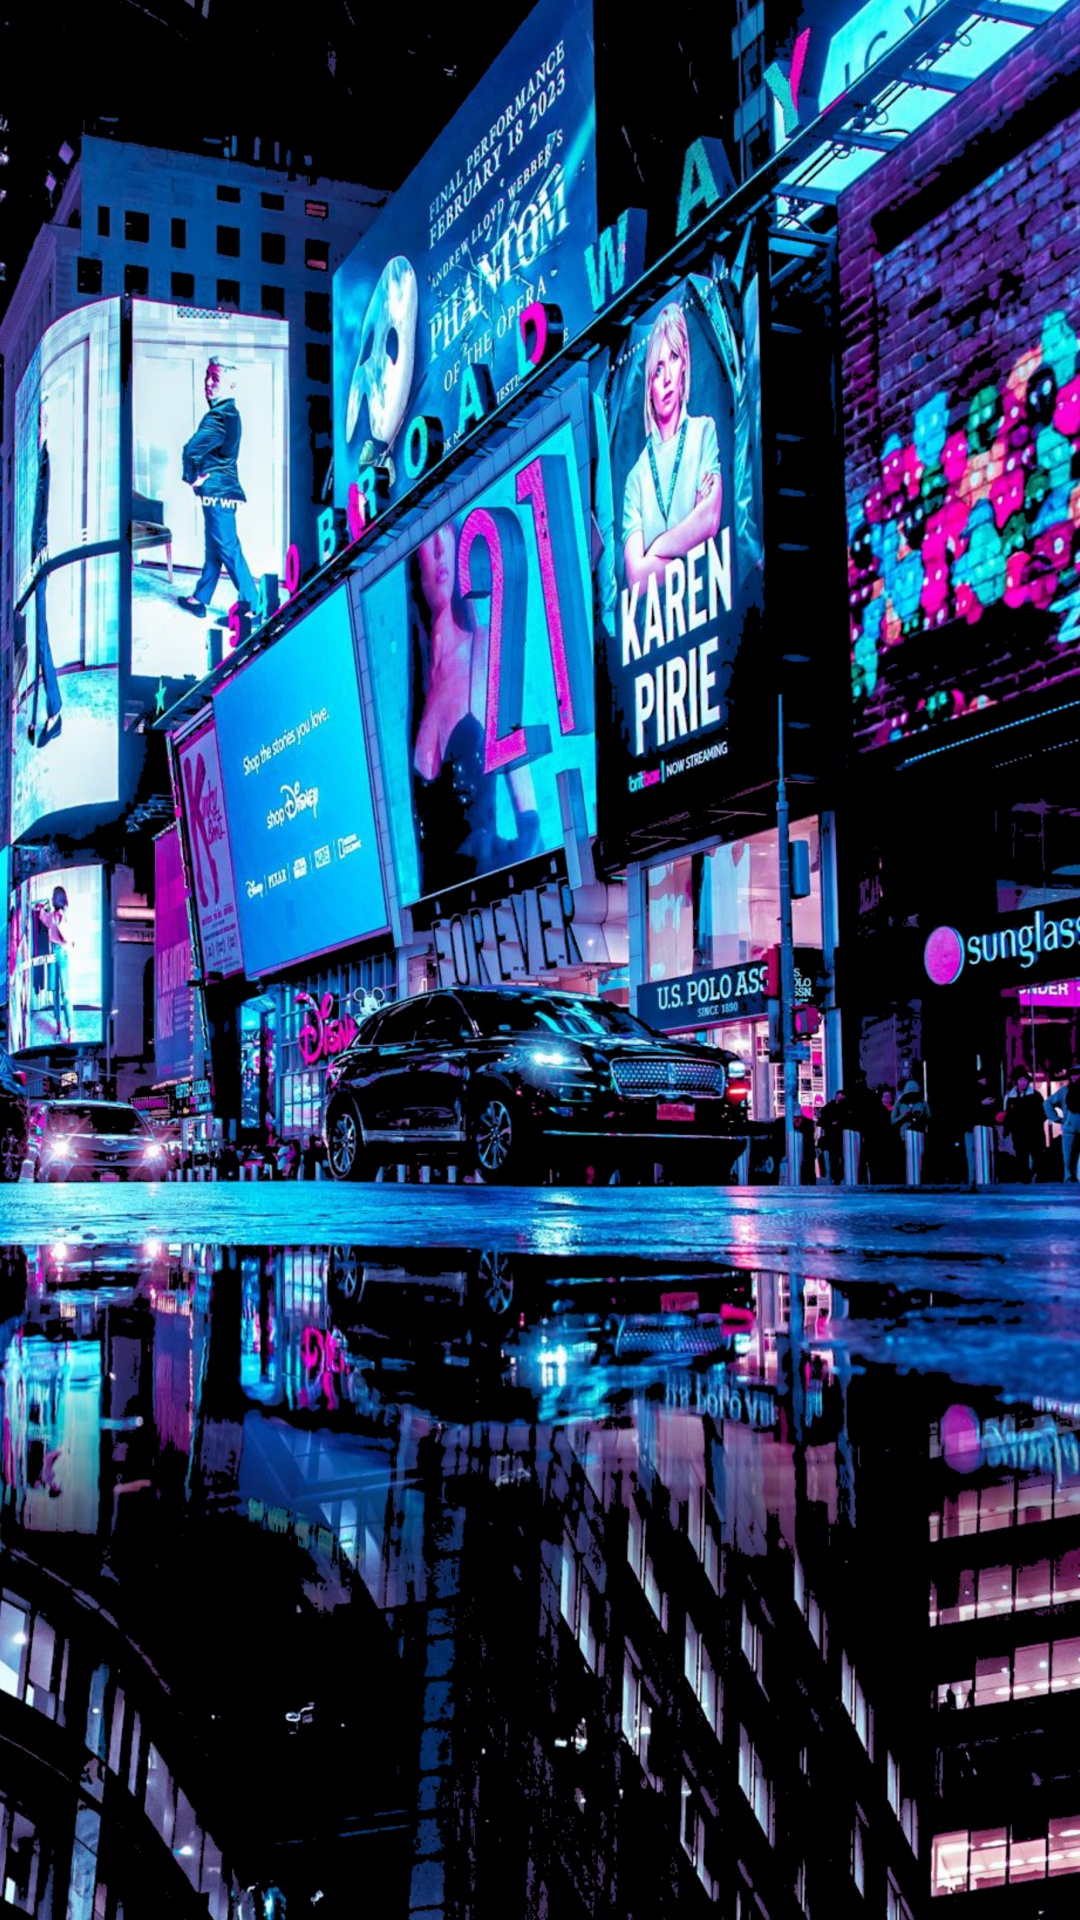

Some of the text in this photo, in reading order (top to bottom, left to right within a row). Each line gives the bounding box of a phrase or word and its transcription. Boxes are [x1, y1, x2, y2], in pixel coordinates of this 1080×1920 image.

[429, 40, 565, 222] FINAL PERFORMANCE
[429, 68, 566, 249] FEBRUARY 18 2023
[428, 166, 570, 364] PHANTOM
[431, 129, 563, 288] ANDREW LLOYD WEBBER'S
[444, 358, 461, 392] OF
[465, 328, 492, 365] THE
[496, 275, 547, 338] OPERA
[458, 455, 580, 775] 21
[621, 526, 732, 668] KAREN
[243, 707, 329, 776] Shop the stories you love.
[634, 636, 721, 756] PIRIE
[666, 759, 685, 777] NOW
[686, 741, 728, 769] STREAMING
[267, 809, 284, 830] shop
[431, 876, 583, 988] FOREVER
[657, 984, 683, 1010] U.S.
[687, 974, 731, 1005] POLO
[697, 1002, 738, 1017] SINCE 1890
